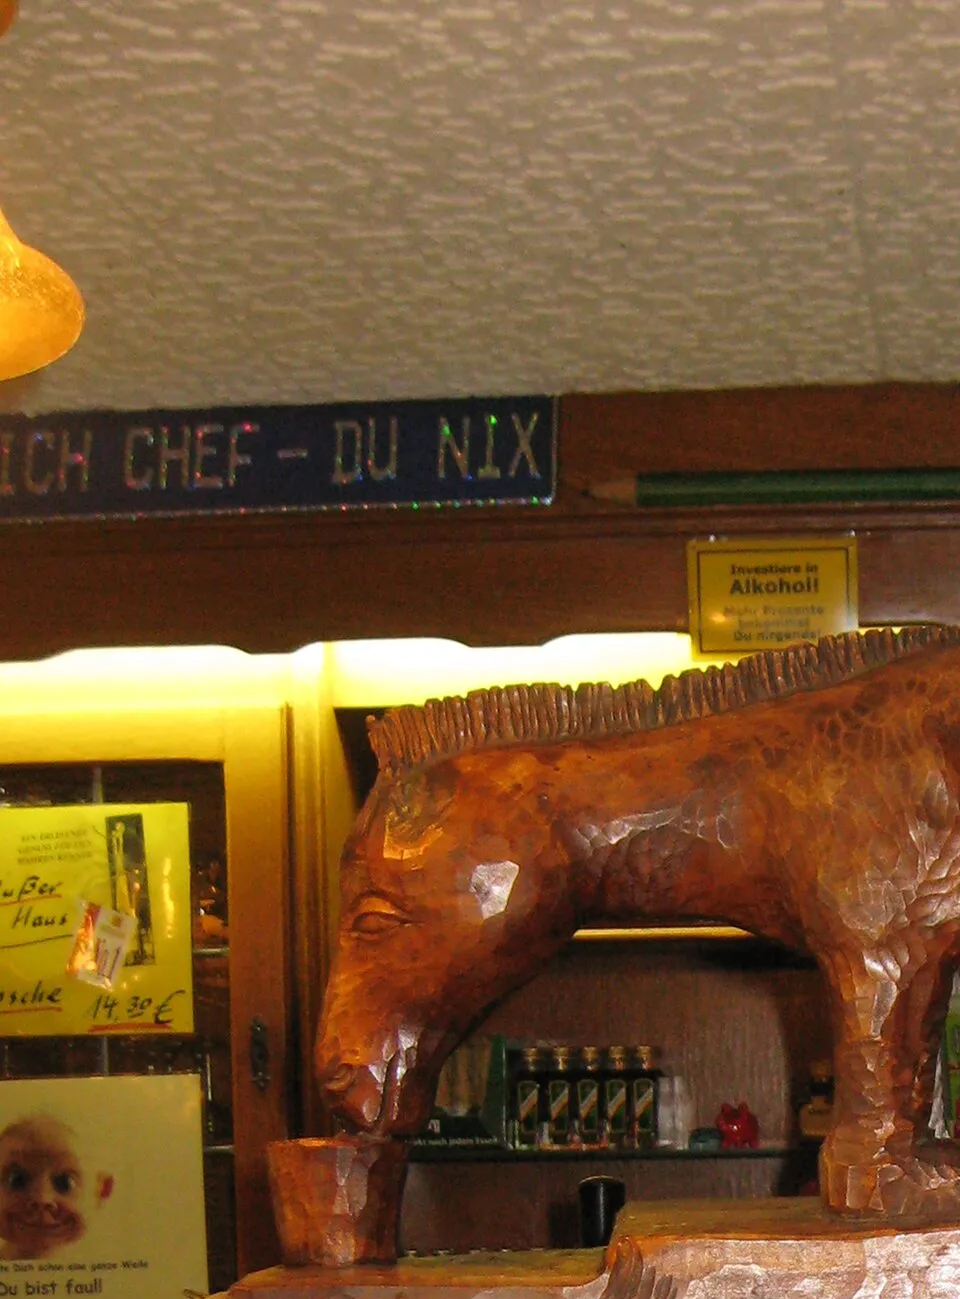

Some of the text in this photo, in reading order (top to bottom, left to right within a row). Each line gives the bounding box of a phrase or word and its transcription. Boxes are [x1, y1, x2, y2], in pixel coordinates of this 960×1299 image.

[125, 422, 260, 490] CHEF
[333, 416, 398, 484] DU
[436, 412, 542, 481] NIX
[730, 563, 819, 575] Investiere in
[0, 875, 63, 901] ußer
[11, 906, 69, 929] Haus
[25, 1280, 58, 1296] bist
